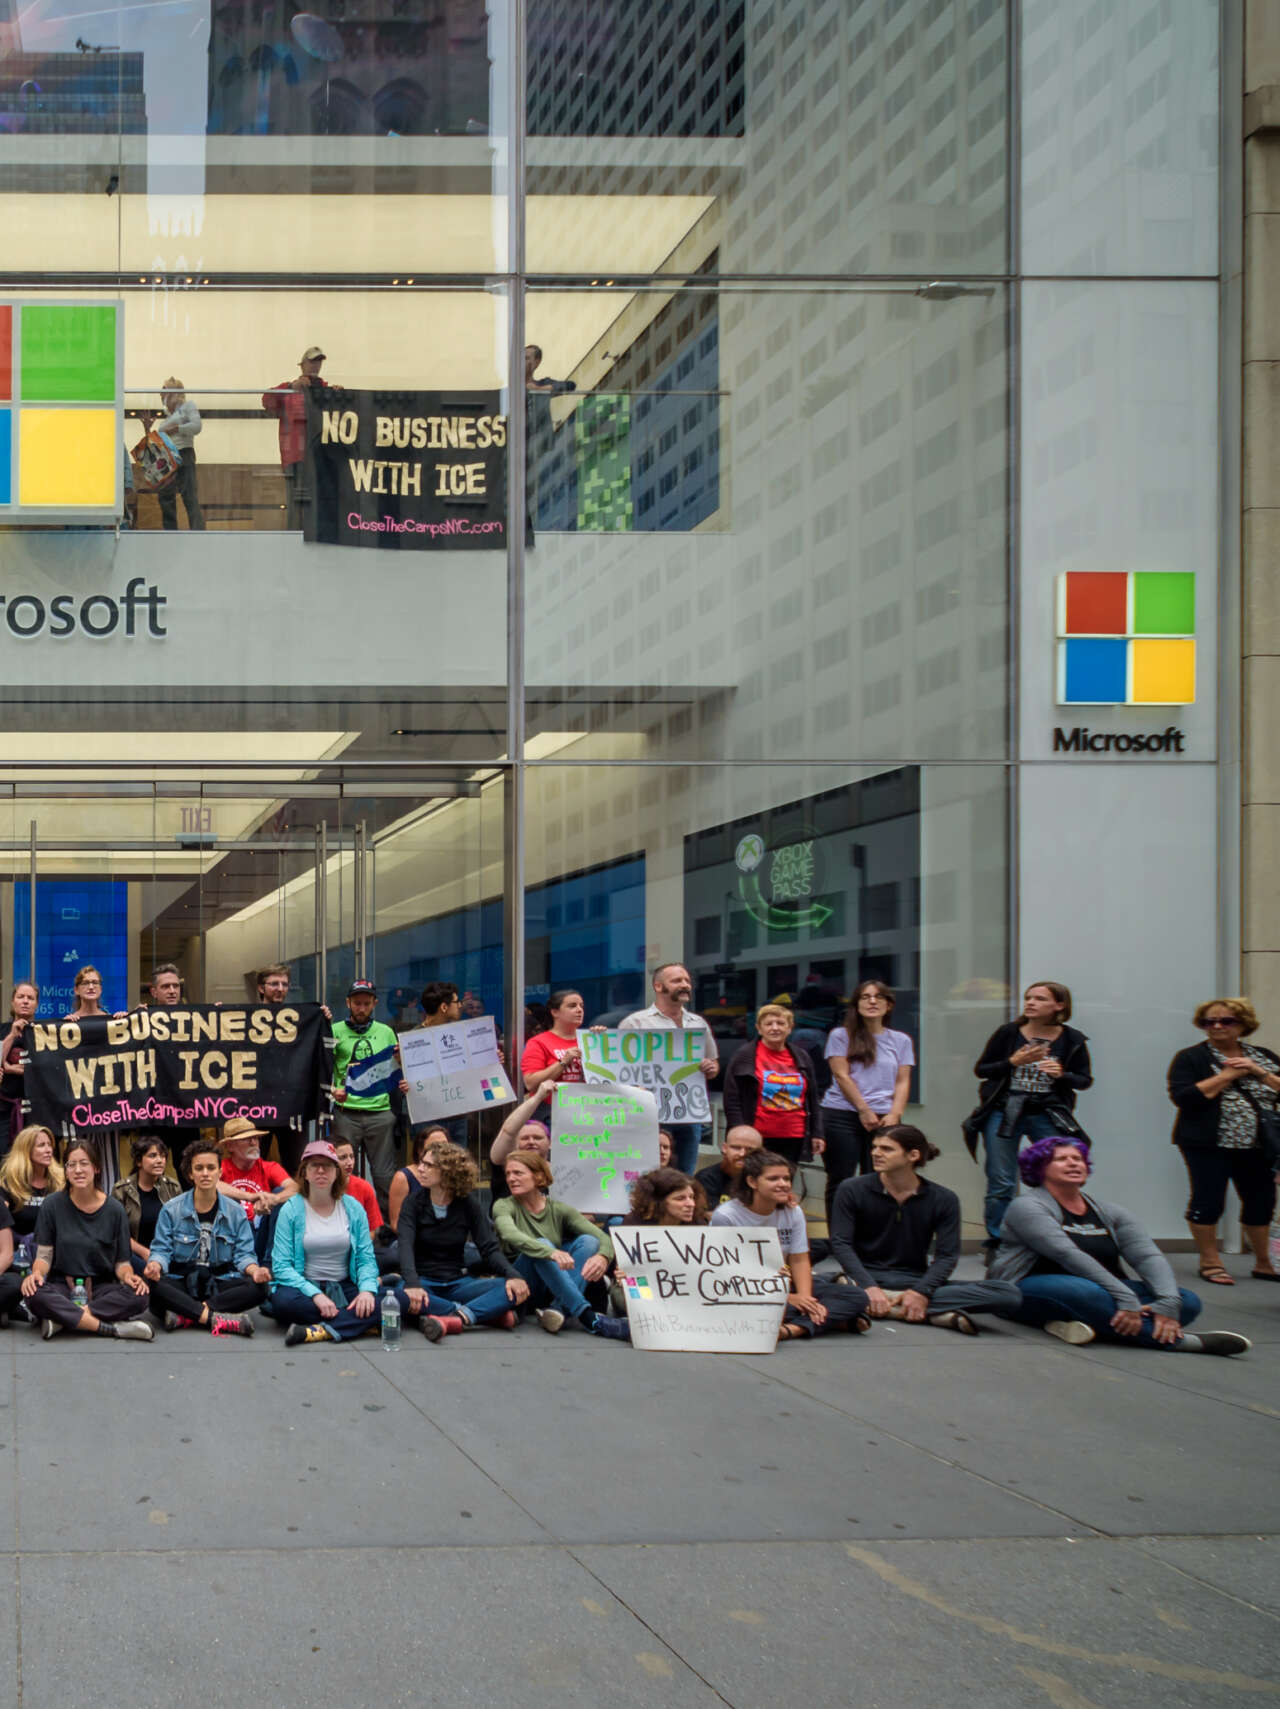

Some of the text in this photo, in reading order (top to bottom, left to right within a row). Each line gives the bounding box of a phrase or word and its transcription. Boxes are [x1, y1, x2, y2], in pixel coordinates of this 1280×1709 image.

[321, 410, 507, 449] NO BUSINESS
[348, 458, 487, 496] WITH ICE
[347, 512, 503, 539] CloseTheCampsNYC.com
[1053, 726, 1185, 753] Microsoft
[772, 840, 814, 866] XBOX
[770, 857, 815, 884] GAME
[773, 877, 811, 901] PASS
[34, 1008, 300, 1052] NO BUSINESS
[582, 1031, 704, 1063] PEOPLE
[65, 1048, 257, 1100] WITH ICE
[620, 1063, 666, 1086] OVER
[72, 1096, 278, 1127] CloseTheCampsNYC.com
[614, 1231, 662, 1265] WE
[664, 1230, 770, 1267] WON'T
[656, 1269, 792, 1302] BE COMPLICIT
